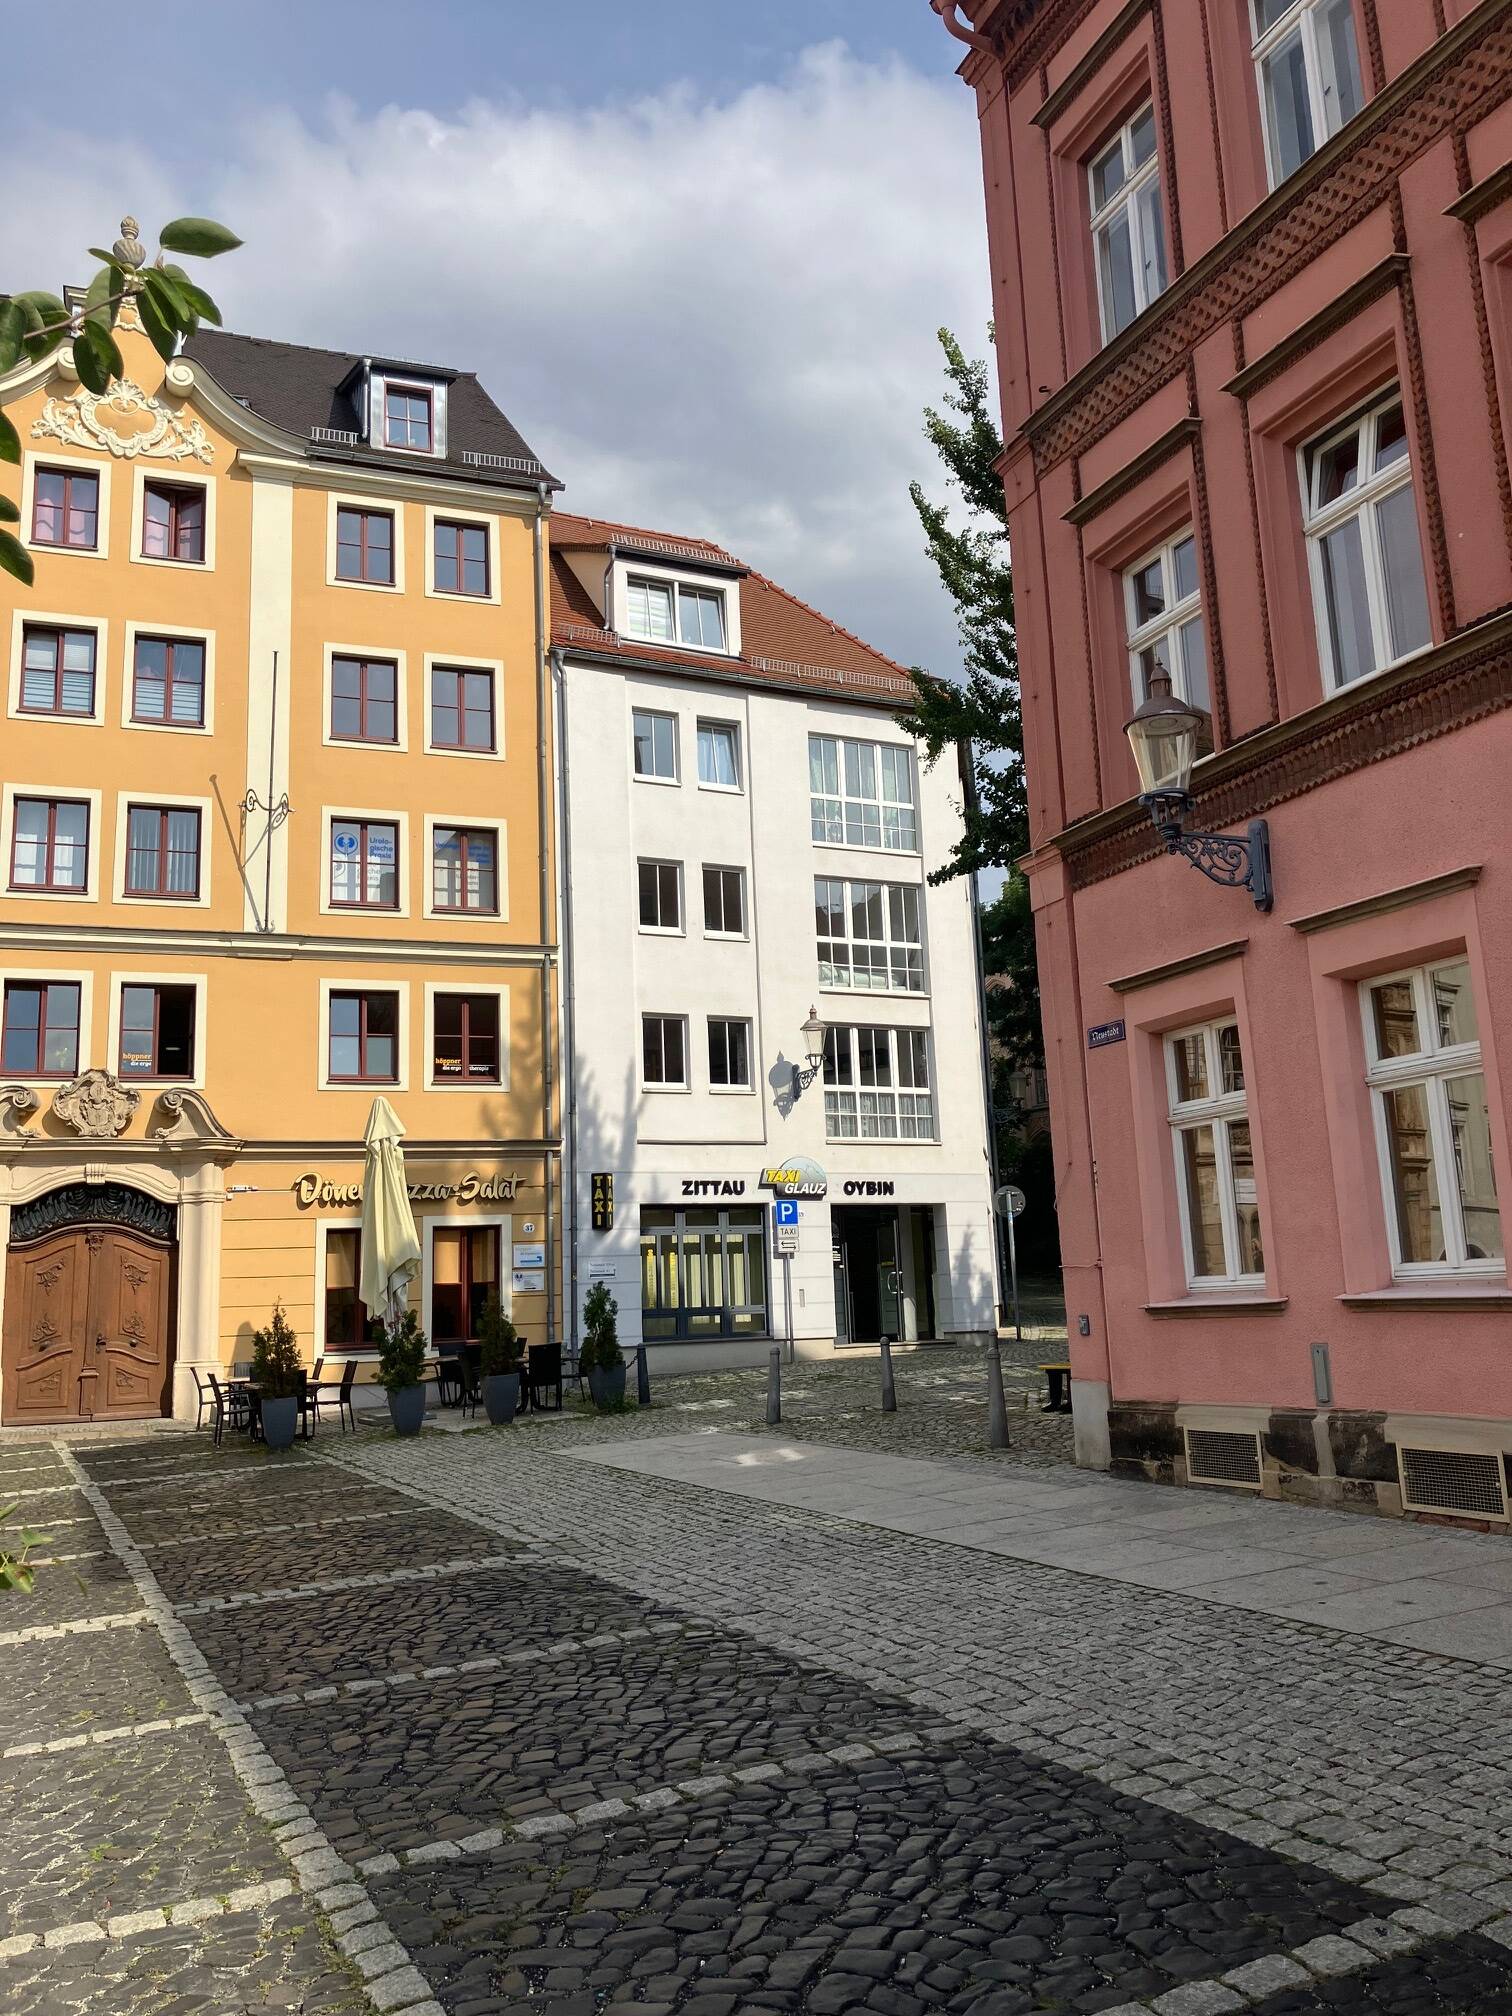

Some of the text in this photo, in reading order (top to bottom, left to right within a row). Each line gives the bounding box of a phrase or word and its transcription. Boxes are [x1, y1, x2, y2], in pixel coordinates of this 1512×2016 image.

[766, 1169, 801, 1183] TAXI
[406, 1183, 450, 1200] zza
[460, 1170, 528, 1200] Salat
[681, 1180, 746, 1196] ZITTAU
[784, 1182, 827, 1195] GLAUZ
[843, 1180, 895, 1196] OYBIN
[593, 1175, 605, 1226] TAXI
[781, 1203, 793, 1222] P
[524, 1224, 534, 1232] 37
[780, 1227, 797, 1236] TAXI
